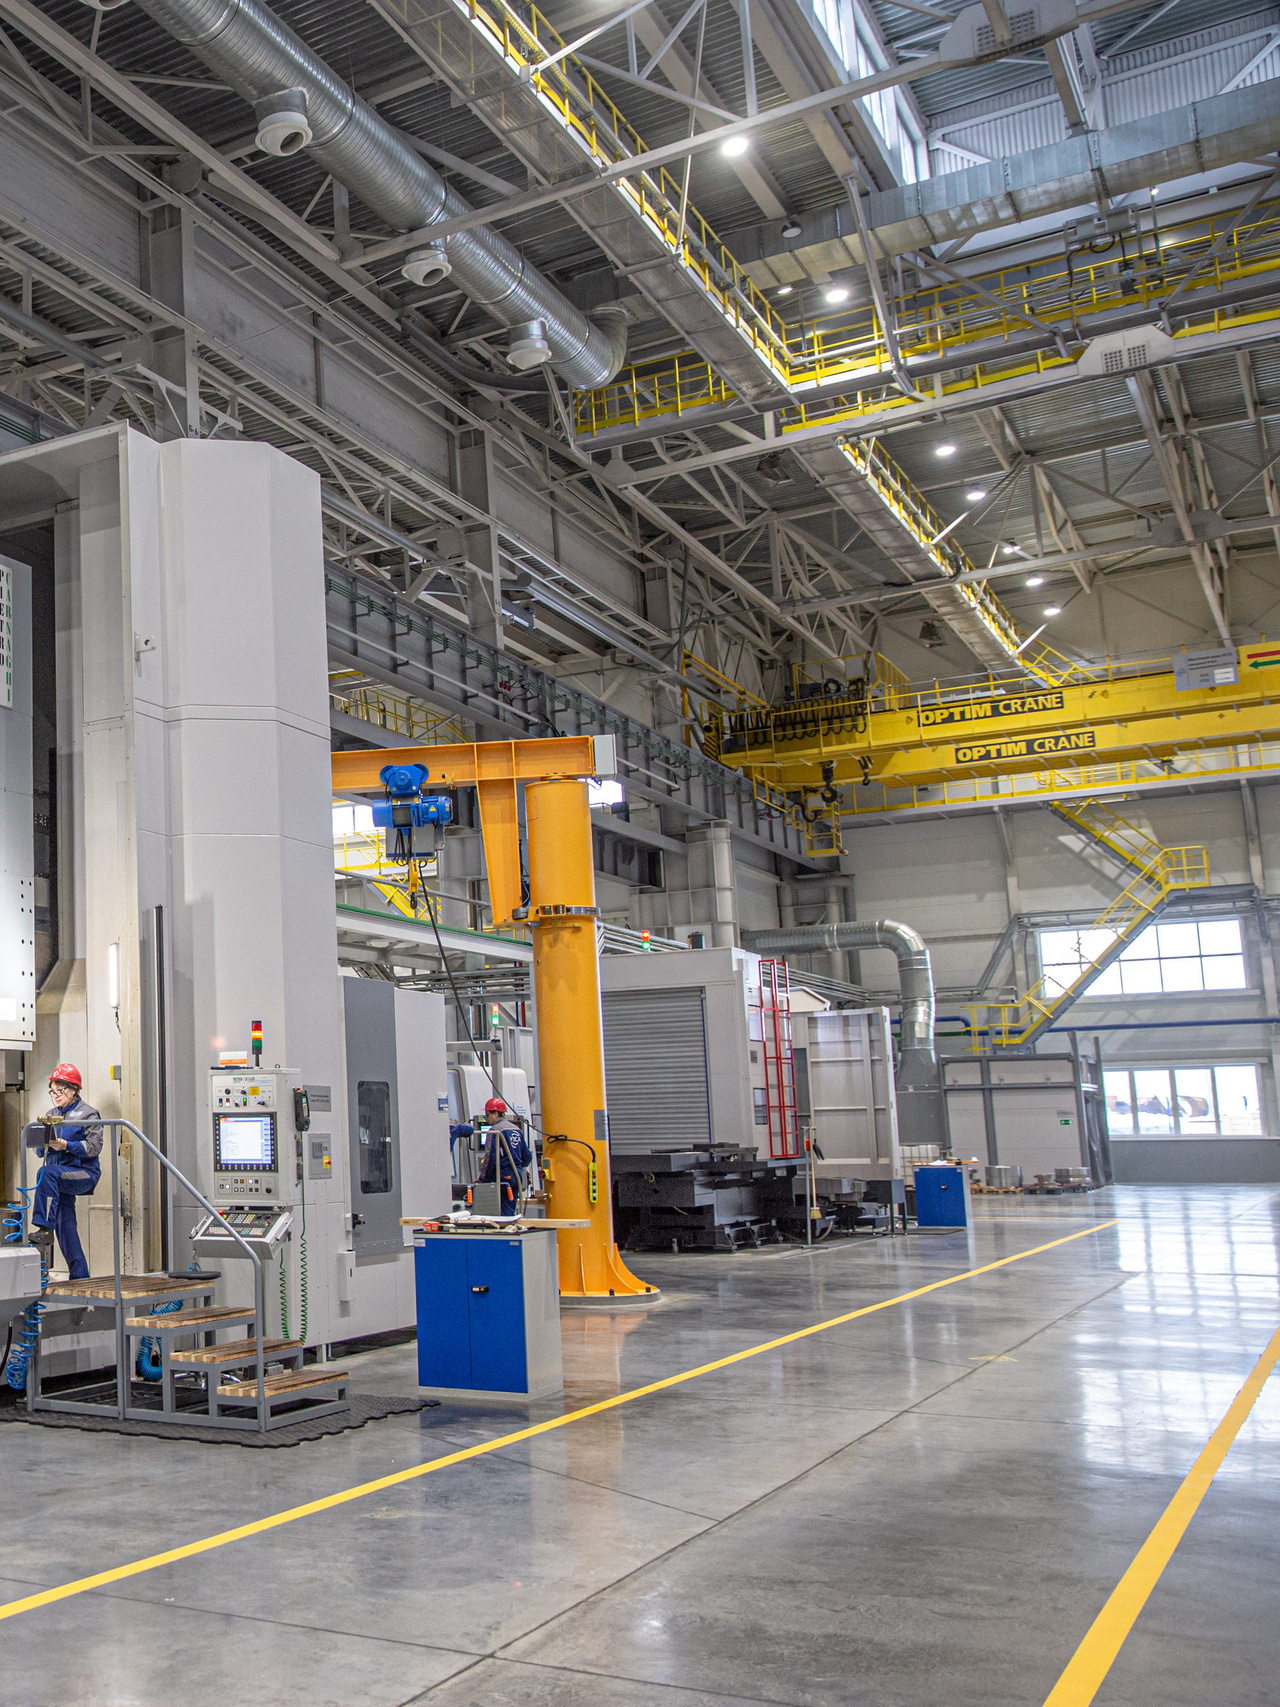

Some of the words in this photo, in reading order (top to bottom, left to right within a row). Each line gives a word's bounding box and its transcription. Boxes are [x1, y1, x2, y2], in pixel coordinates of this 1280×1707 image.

[920, 703, 992, 725] OPTIM
[998, 693, 1063, 715] CRANE
[957, 741, 1027, 762] OPTIM
[1033, 732, 1094, 753] CRANE
